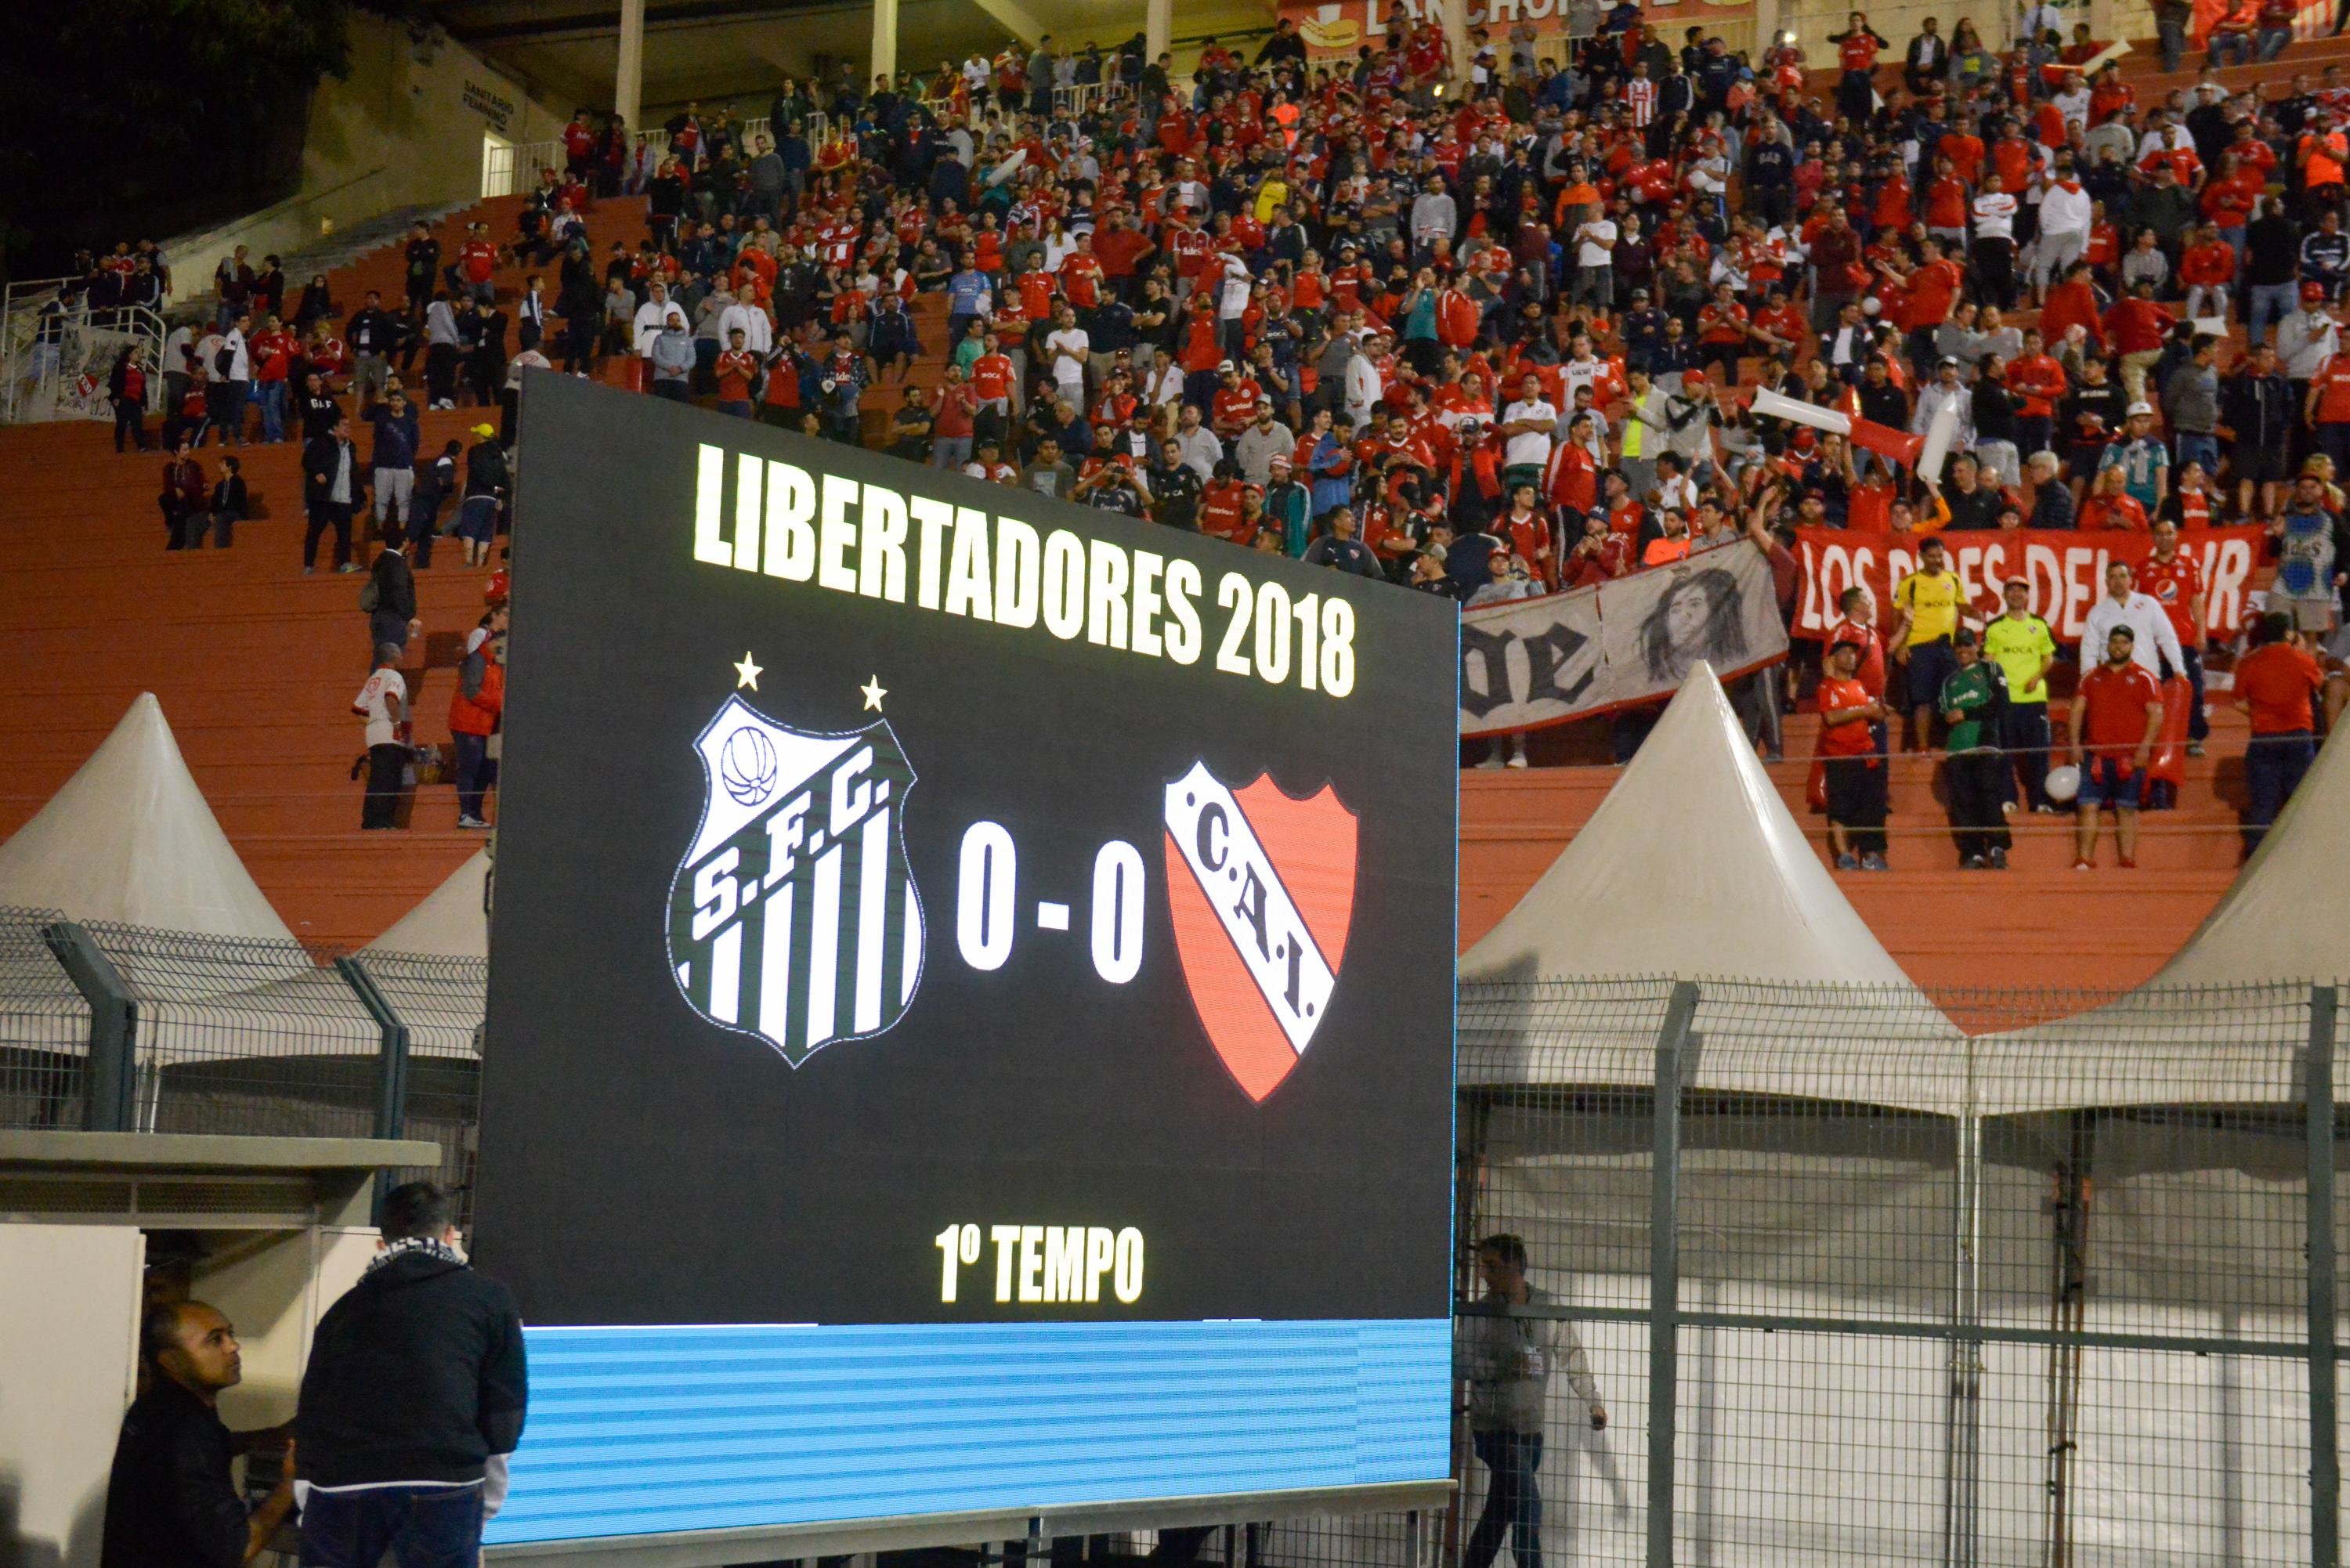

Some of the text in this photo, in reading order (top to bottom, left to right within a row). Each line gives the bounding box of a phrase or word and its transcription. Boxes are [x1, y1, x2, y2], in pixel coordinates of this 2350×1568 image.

[694, 443, 1355, 698] LIBERTADORES 2018
[1801, 542, 1877, 630] LOS
[1888, 543, 2007, 633] PES
[956, 821, 1017, 971] 0
[1090, 840, 1145, 984] 0
[991, 1224, 1144, 1303] TEMPO
